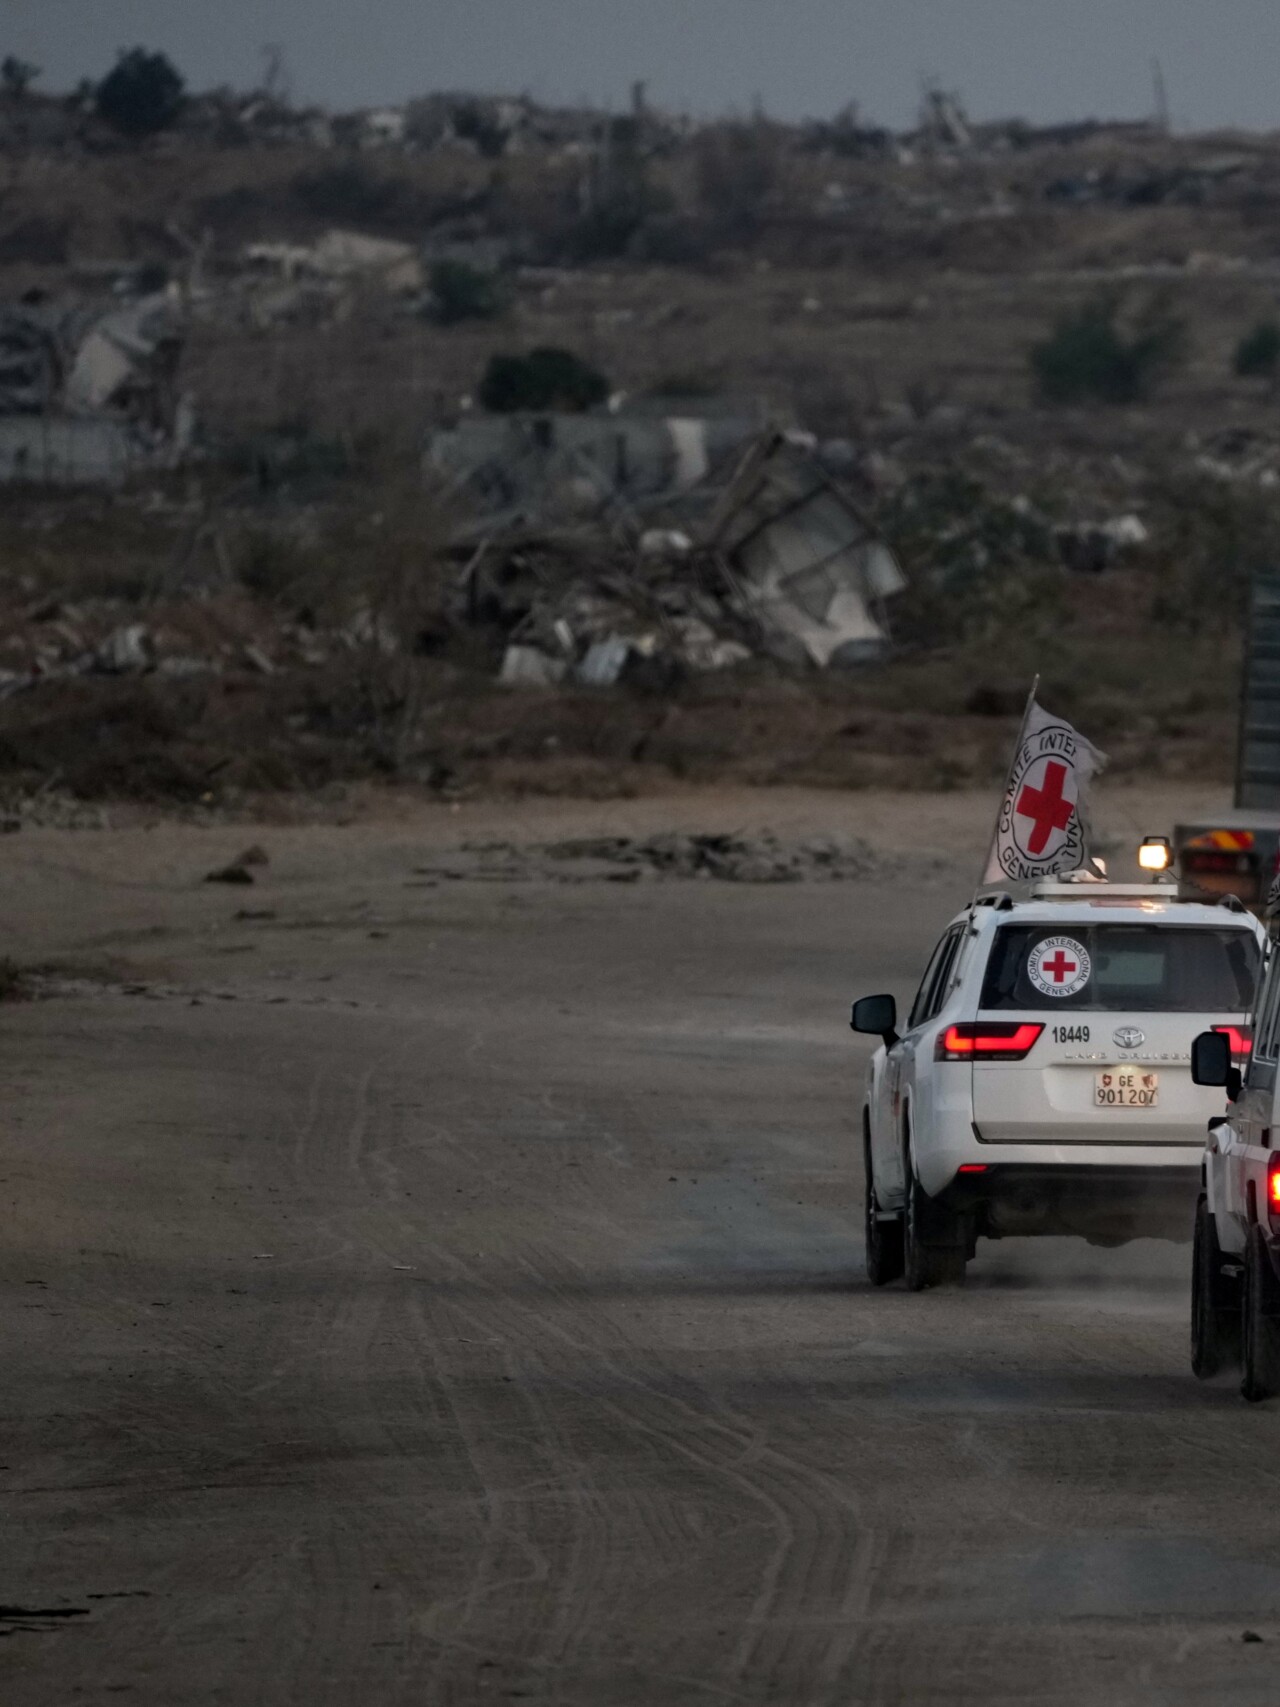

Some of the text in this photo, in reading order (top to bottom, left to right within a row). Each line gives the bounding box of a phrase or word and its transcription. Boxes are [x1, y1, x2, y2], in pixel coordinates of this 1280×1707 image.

[1000, 743, 1032, 833] COMITE
[1029, 938, 1089, 982] COMITE INTERNATIONAL
[1039, 983, 1078, 995] GENEVE
[1052, 1026, 1090, 1043] 18449
[1119, 1075, 1134, 1087] GE
[1097, 1089, 1156, 1105] 901 207
